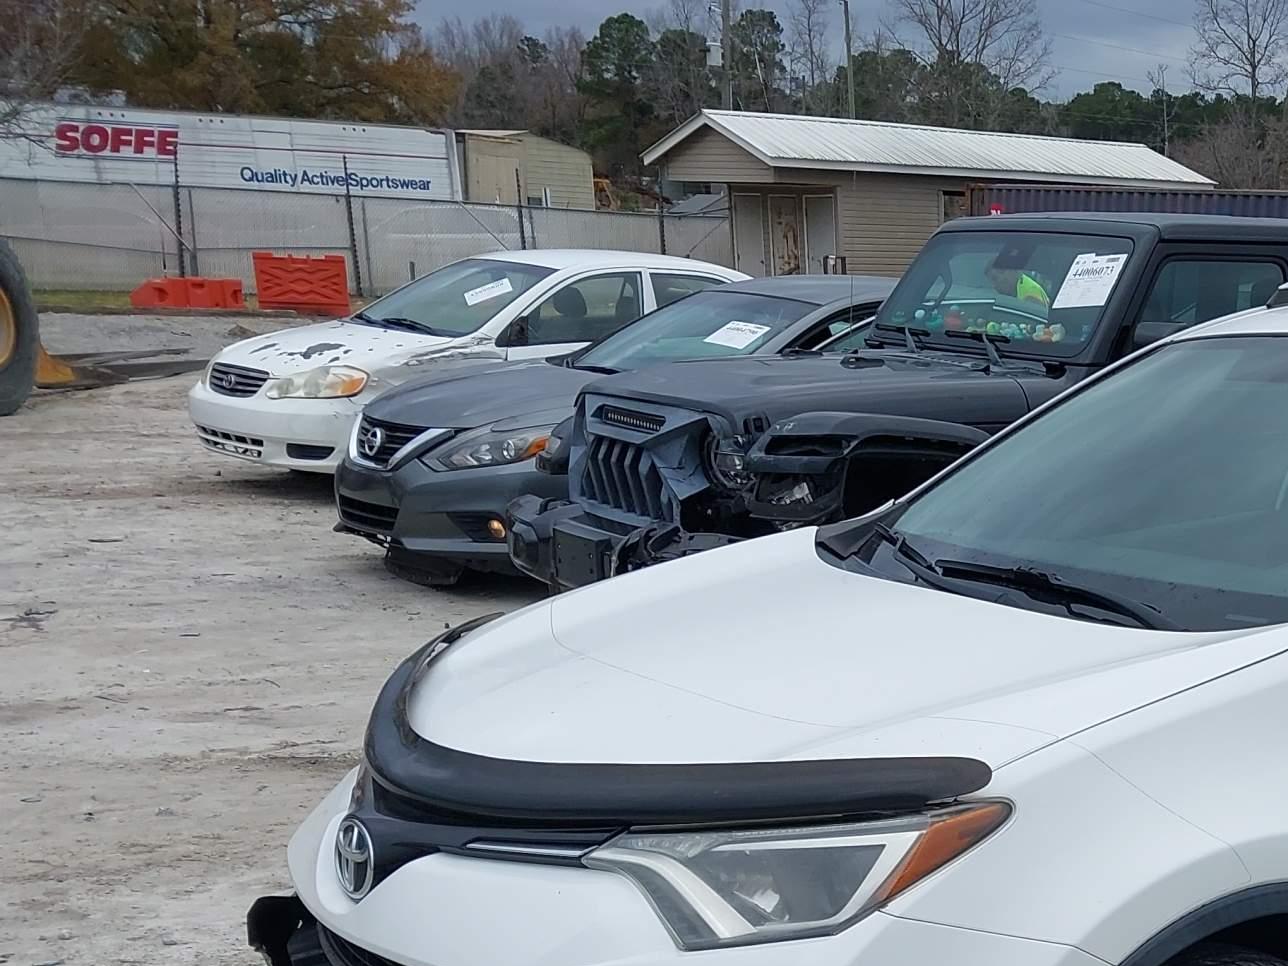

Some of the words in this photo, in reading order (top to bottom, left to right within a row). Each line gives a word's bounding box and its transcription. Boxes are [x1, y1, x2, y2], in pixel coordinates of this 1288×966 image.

[55, 123, 178, 155] SOFFE
[240, 166, 298, 187] Quality
[301, 169, 345, 186] Active
[348, 172, 431, 190] Sportswear
